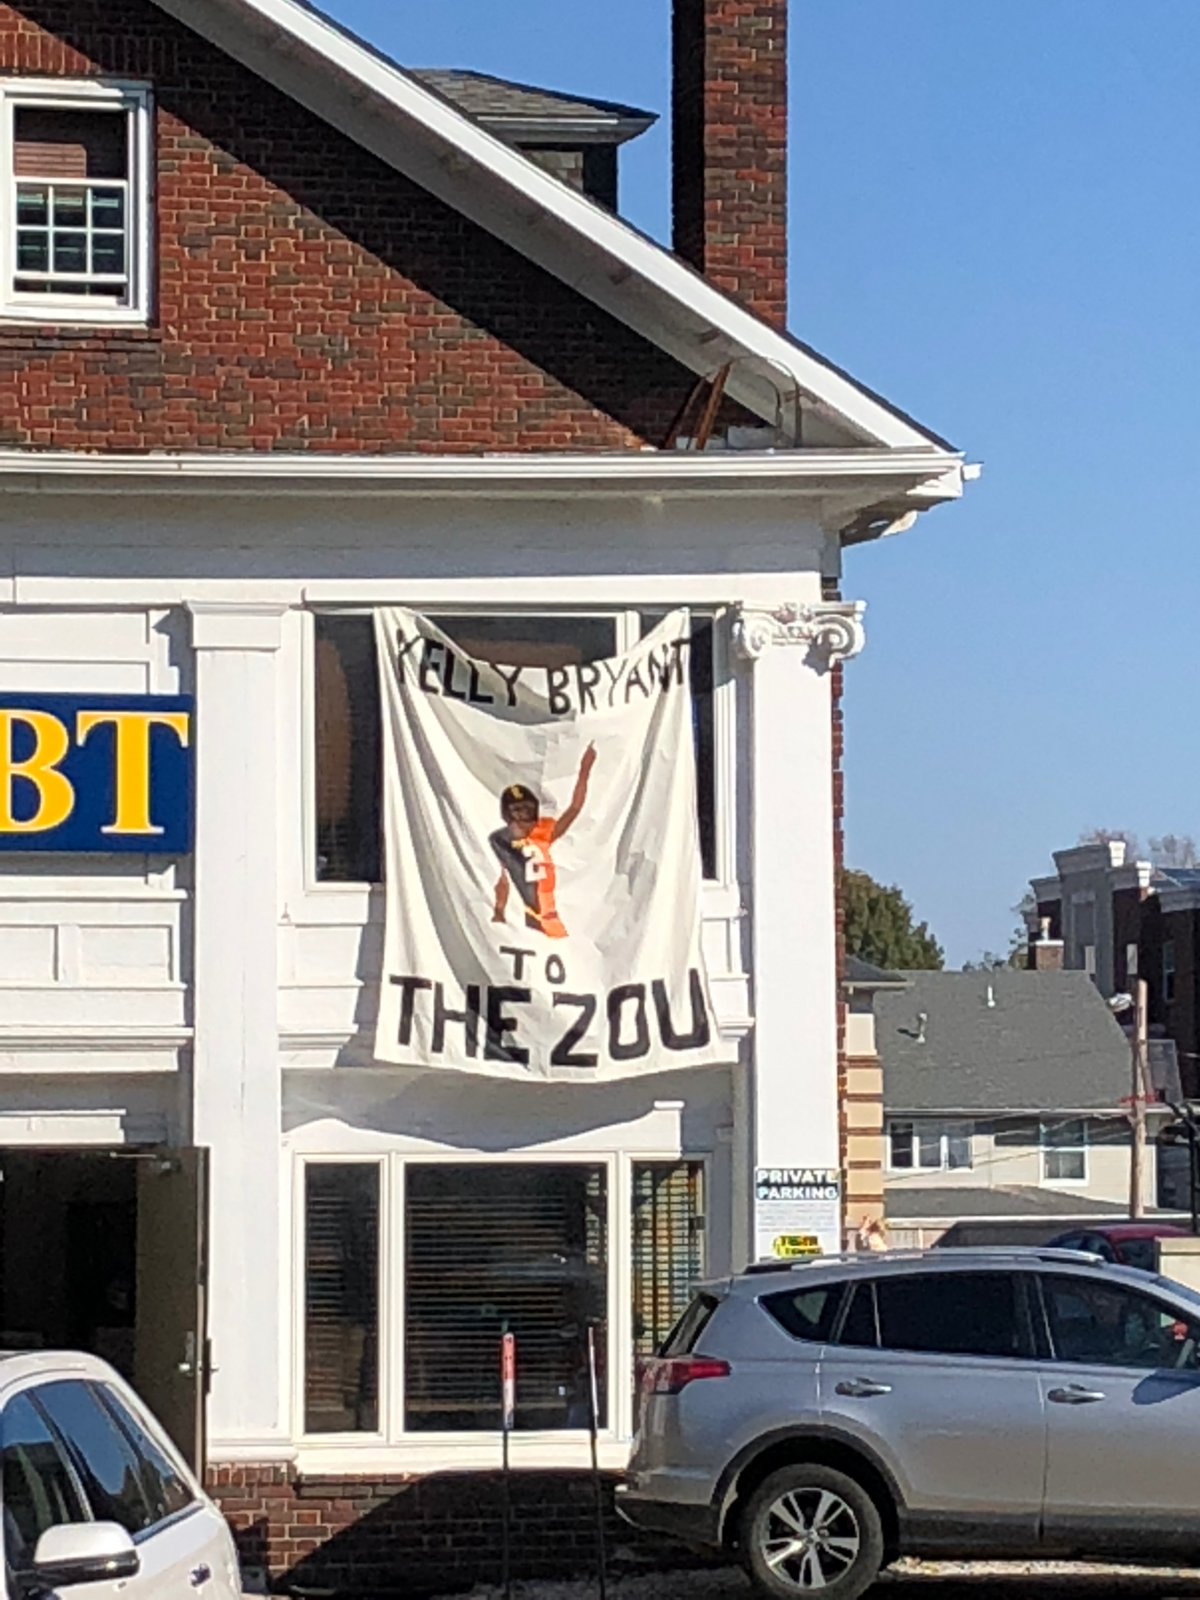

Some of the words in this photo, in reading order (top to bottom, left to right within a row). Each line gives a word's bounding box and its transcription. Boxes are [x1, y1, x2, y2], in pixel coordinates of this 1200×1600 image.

[395, 628, 523, 707] KELLY
[547, 637, 691, 715] BRYANT
[0, 709, 190, 834] BT
[500, 945, 566, 984] TO
[389, 974, 532, 1065] THE
[550, 968, 711, 1067] ZOU
[757, 1169, 838, 1184] PRIVATE
[757, 1186, 838, 1200] PARKING
